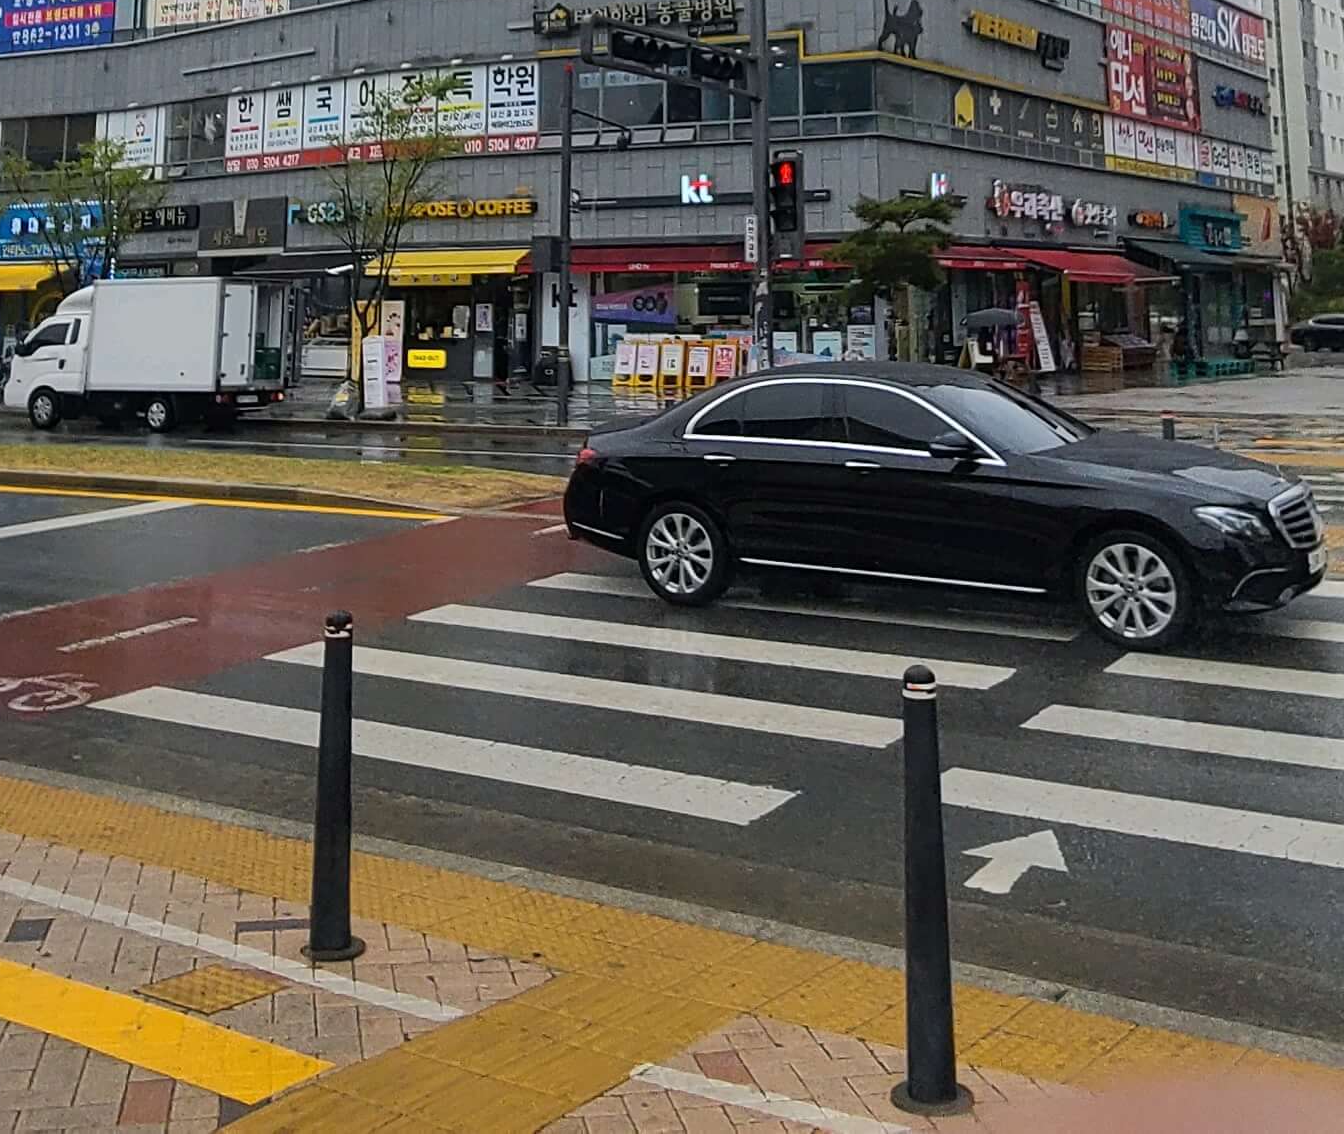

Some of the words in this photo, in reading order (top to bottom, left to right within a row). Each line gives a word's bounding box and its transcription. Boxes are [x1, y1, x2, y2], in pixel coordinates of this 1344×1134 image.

[1217, 6, 1241, 53] SK
[487, 136, 510, 153] 5104
[513, 135, 538, 152] 4217
[282, 152, 301, 167] 4217
[680, 173, 714, 205] kt
[306, 201, 345, 224] GS25
[475, 198, 532, 215] COFFEE
